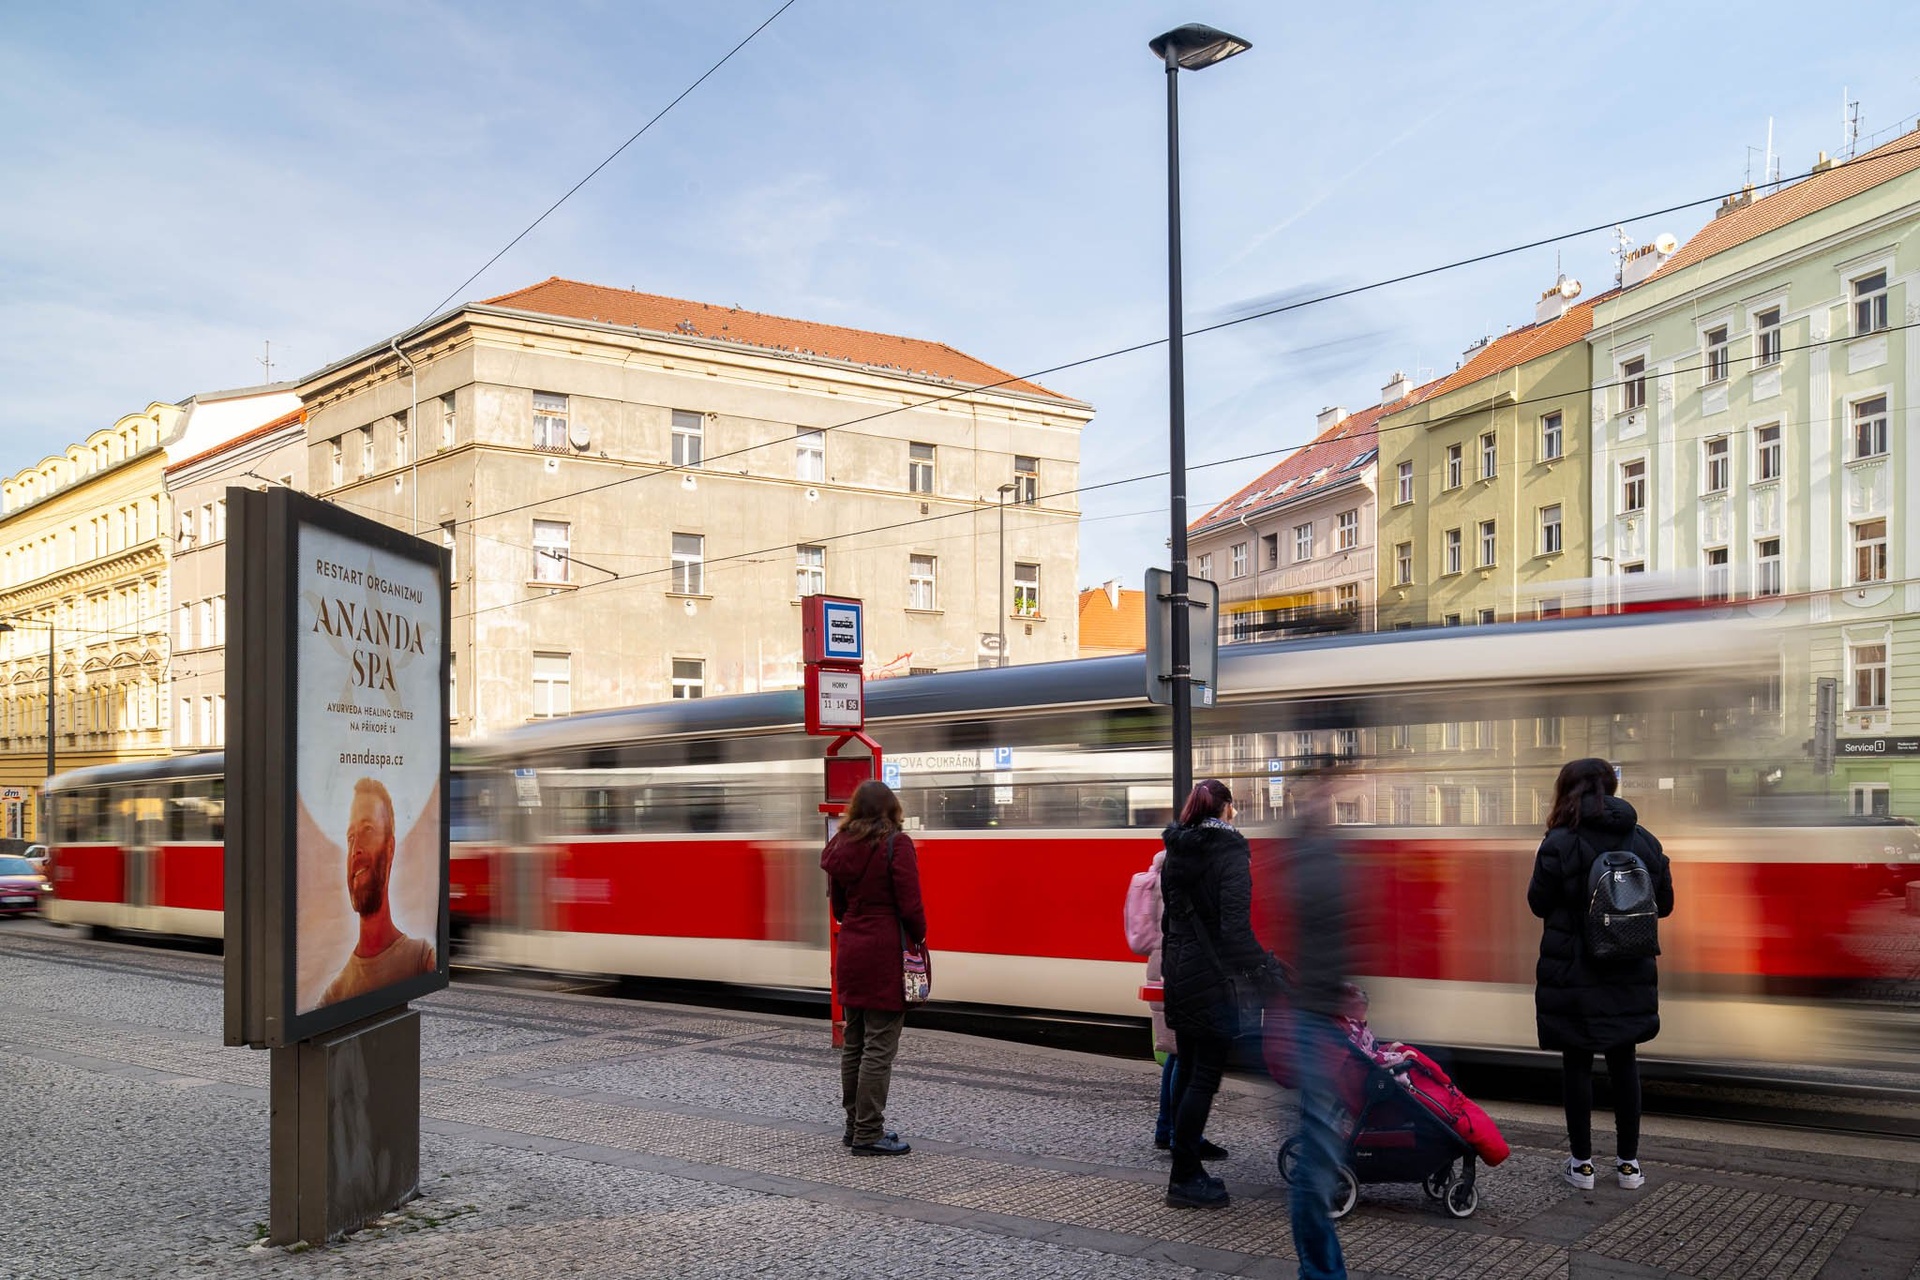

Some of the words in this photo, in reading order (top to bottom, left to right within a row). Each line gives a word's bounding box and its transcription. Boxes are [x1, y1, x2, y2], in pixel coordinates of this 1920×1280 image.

[317, 559, 363, 586] RESTART
[367, 575, 423, 604] ORGANIZMU
[313, 596, 424, 655] ANANDA
[352, 649, 396, 691] SPA
[327, 703, 362, 715] AYURVEDA
[364, 707, 391, 718] HEALING
[393, 710, 414, 720] CENTER
[824, 700, 832, 709] 11
[836, 700, 845, 709] 14
[350, 722, 359, 731] NA
[361, 720, 387, 733] PŘÍKOPĚ
[389, 725, 396, 734] 14
[998, 747, 1009, 763] P
[1845, 743, 1874, 752] Service
[340, 748, 403, 769] anandaspa.cz
[926, 754, 981, 768] CUKRÁRNA
[4, 789, 20, 797] dm
